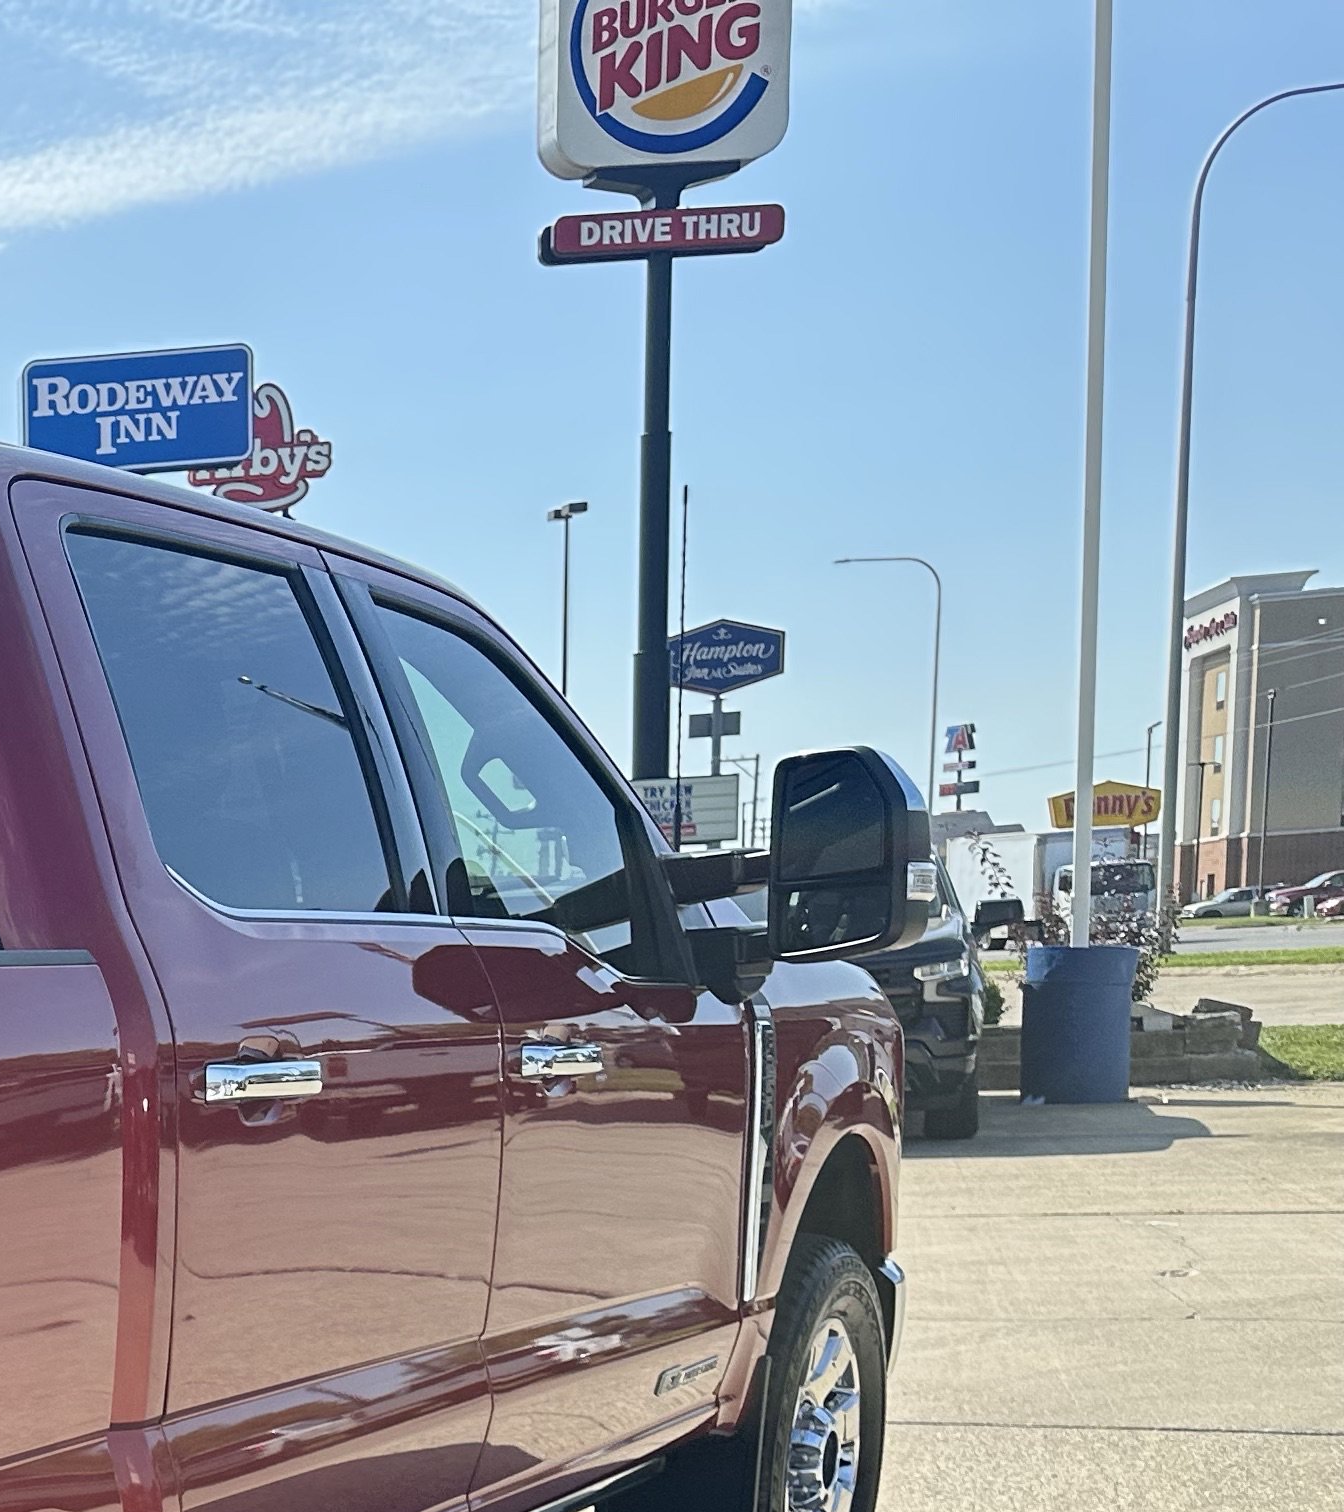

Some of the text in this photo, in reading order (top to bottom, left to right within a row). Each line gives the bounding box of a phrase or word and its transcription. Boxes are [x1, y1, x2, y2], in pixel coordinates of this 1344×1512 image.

[592, 0, 737, 55] BUR
[598, 2, 762, 112] KING
[579, 211, 762, 247] DRIVE THRU
[682, 641, 775, 665] Hampton
[643, 786, 665, 798] TRY
[645, 799, 692, 811] HICKN
[1063, 791, 1155, 819] Dnny's
